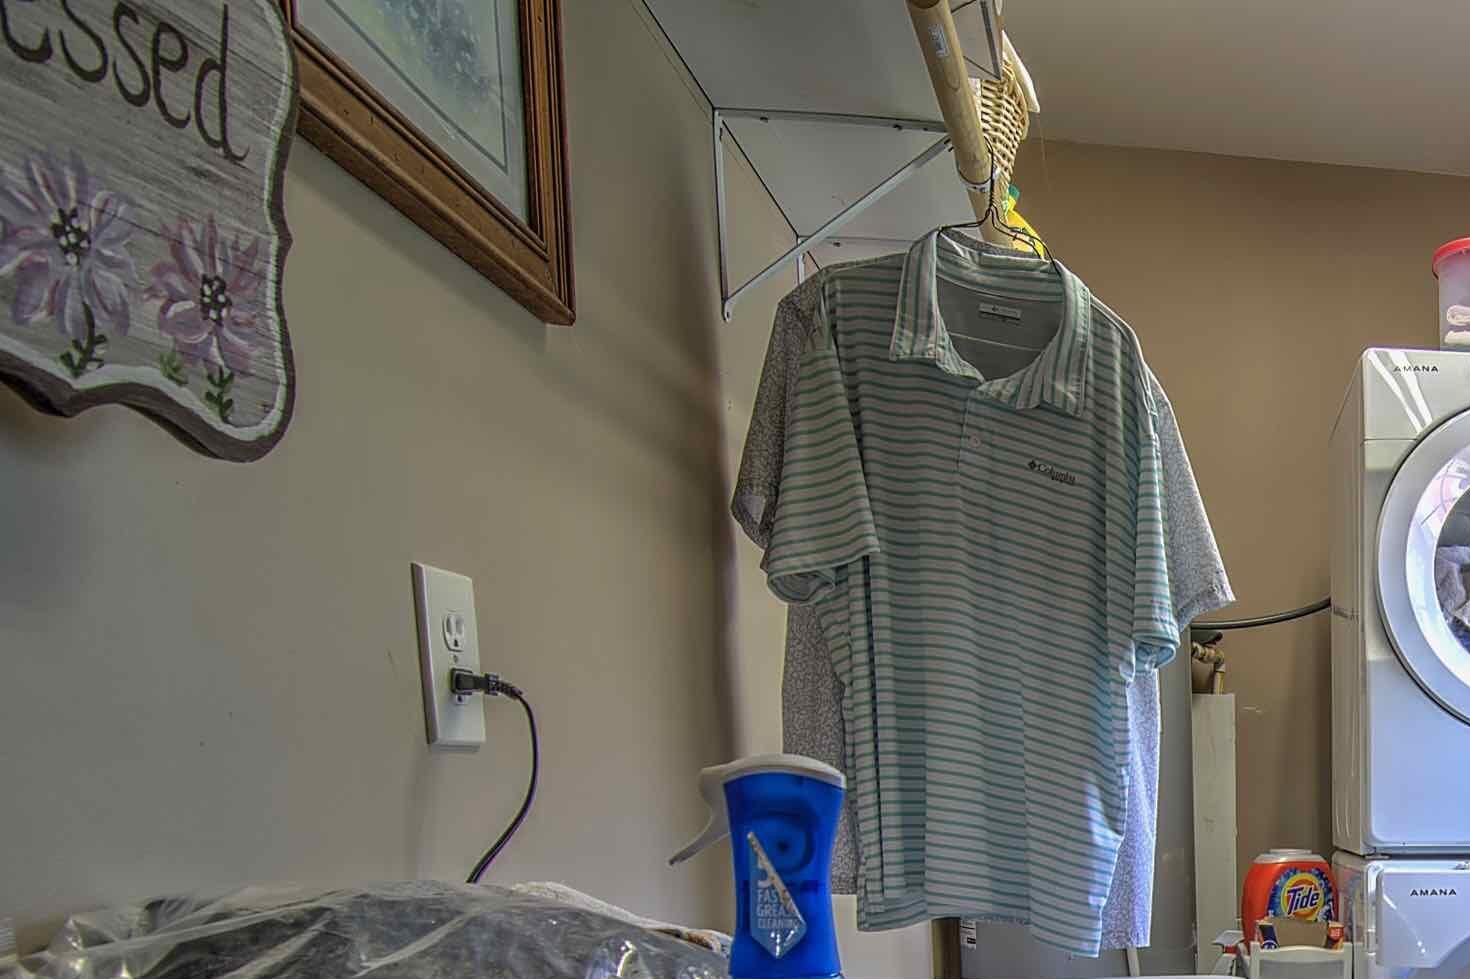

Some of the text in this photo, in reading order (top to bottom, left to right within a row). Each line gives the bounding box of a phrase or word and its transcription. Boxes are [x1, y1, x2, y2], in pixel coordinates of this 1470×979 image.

[1393, 365, 1439, 373] AMANA
[1410, 888, 1457, 897] AMANA
[1286, 885, 1320, 915] Tide
